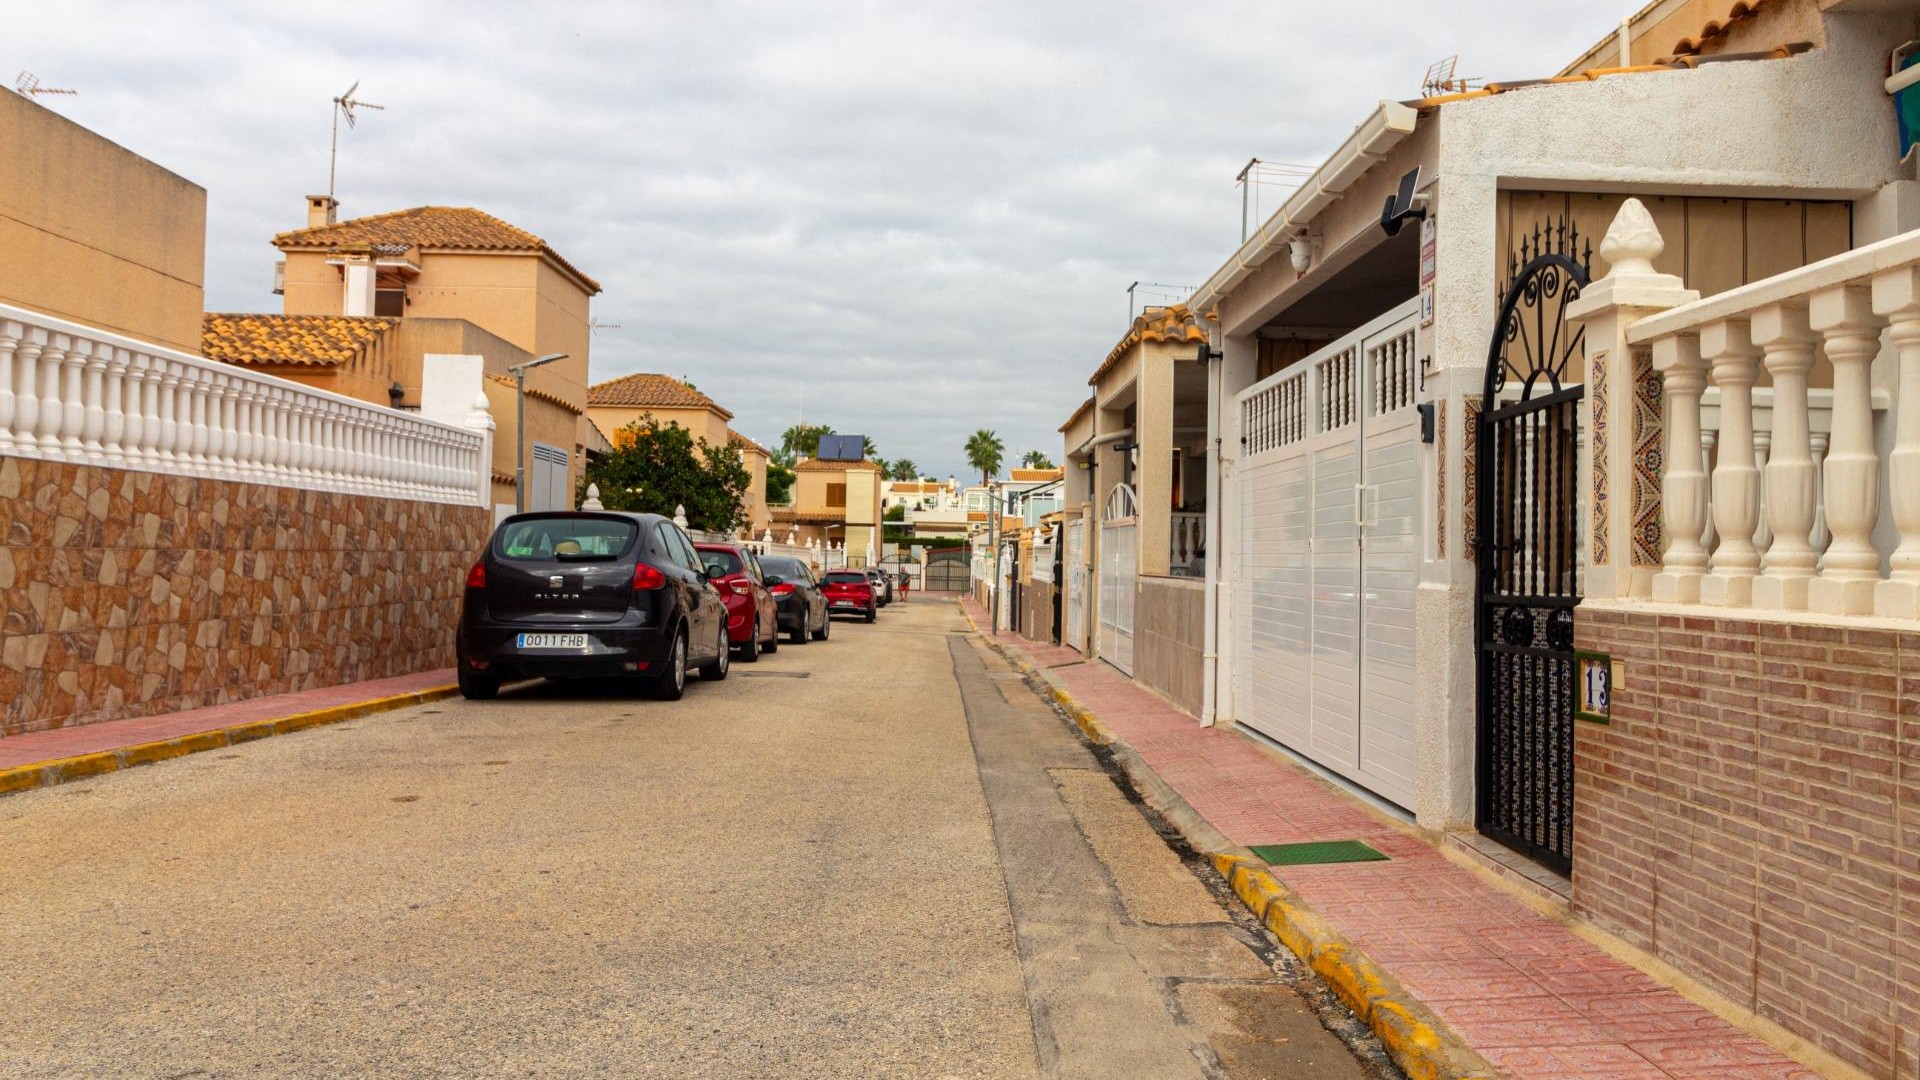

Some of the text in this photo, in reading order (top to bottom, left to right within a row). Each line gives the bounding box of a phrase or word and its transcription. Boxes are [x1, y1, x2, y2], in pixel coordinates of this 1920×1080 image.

[1421, 294, 1431, 319] 14
[526, 635, 584, 647] 0011 FHB
[1586, 668, 1608, 707] 13
